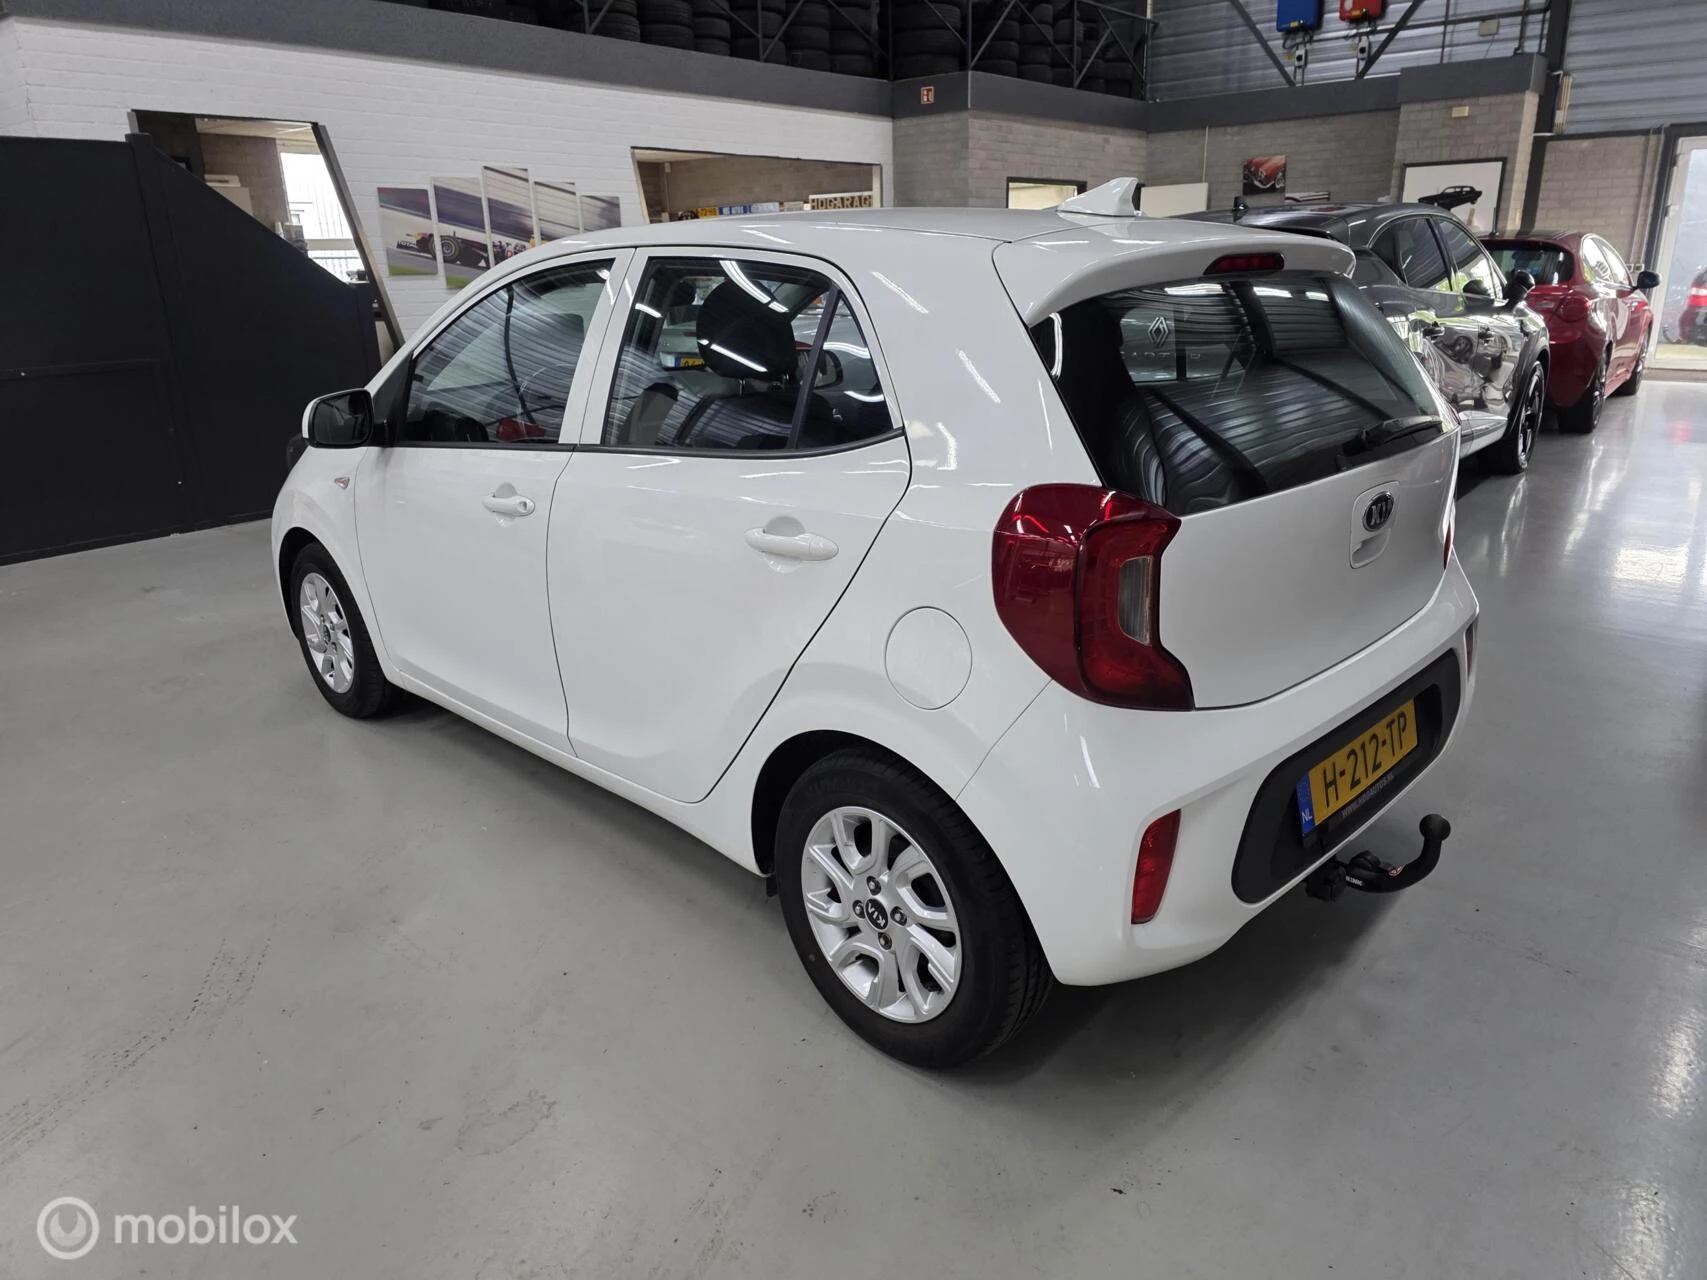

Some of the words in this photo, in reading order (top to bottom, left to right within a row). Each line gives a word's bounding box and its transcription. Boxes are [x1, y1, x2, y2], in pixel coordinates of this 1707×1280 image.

[1323, 711, 1408, 809] H-212-TP
[1301, 808, 1313, 823] NL
[868, 900, 886, 927] KIA
